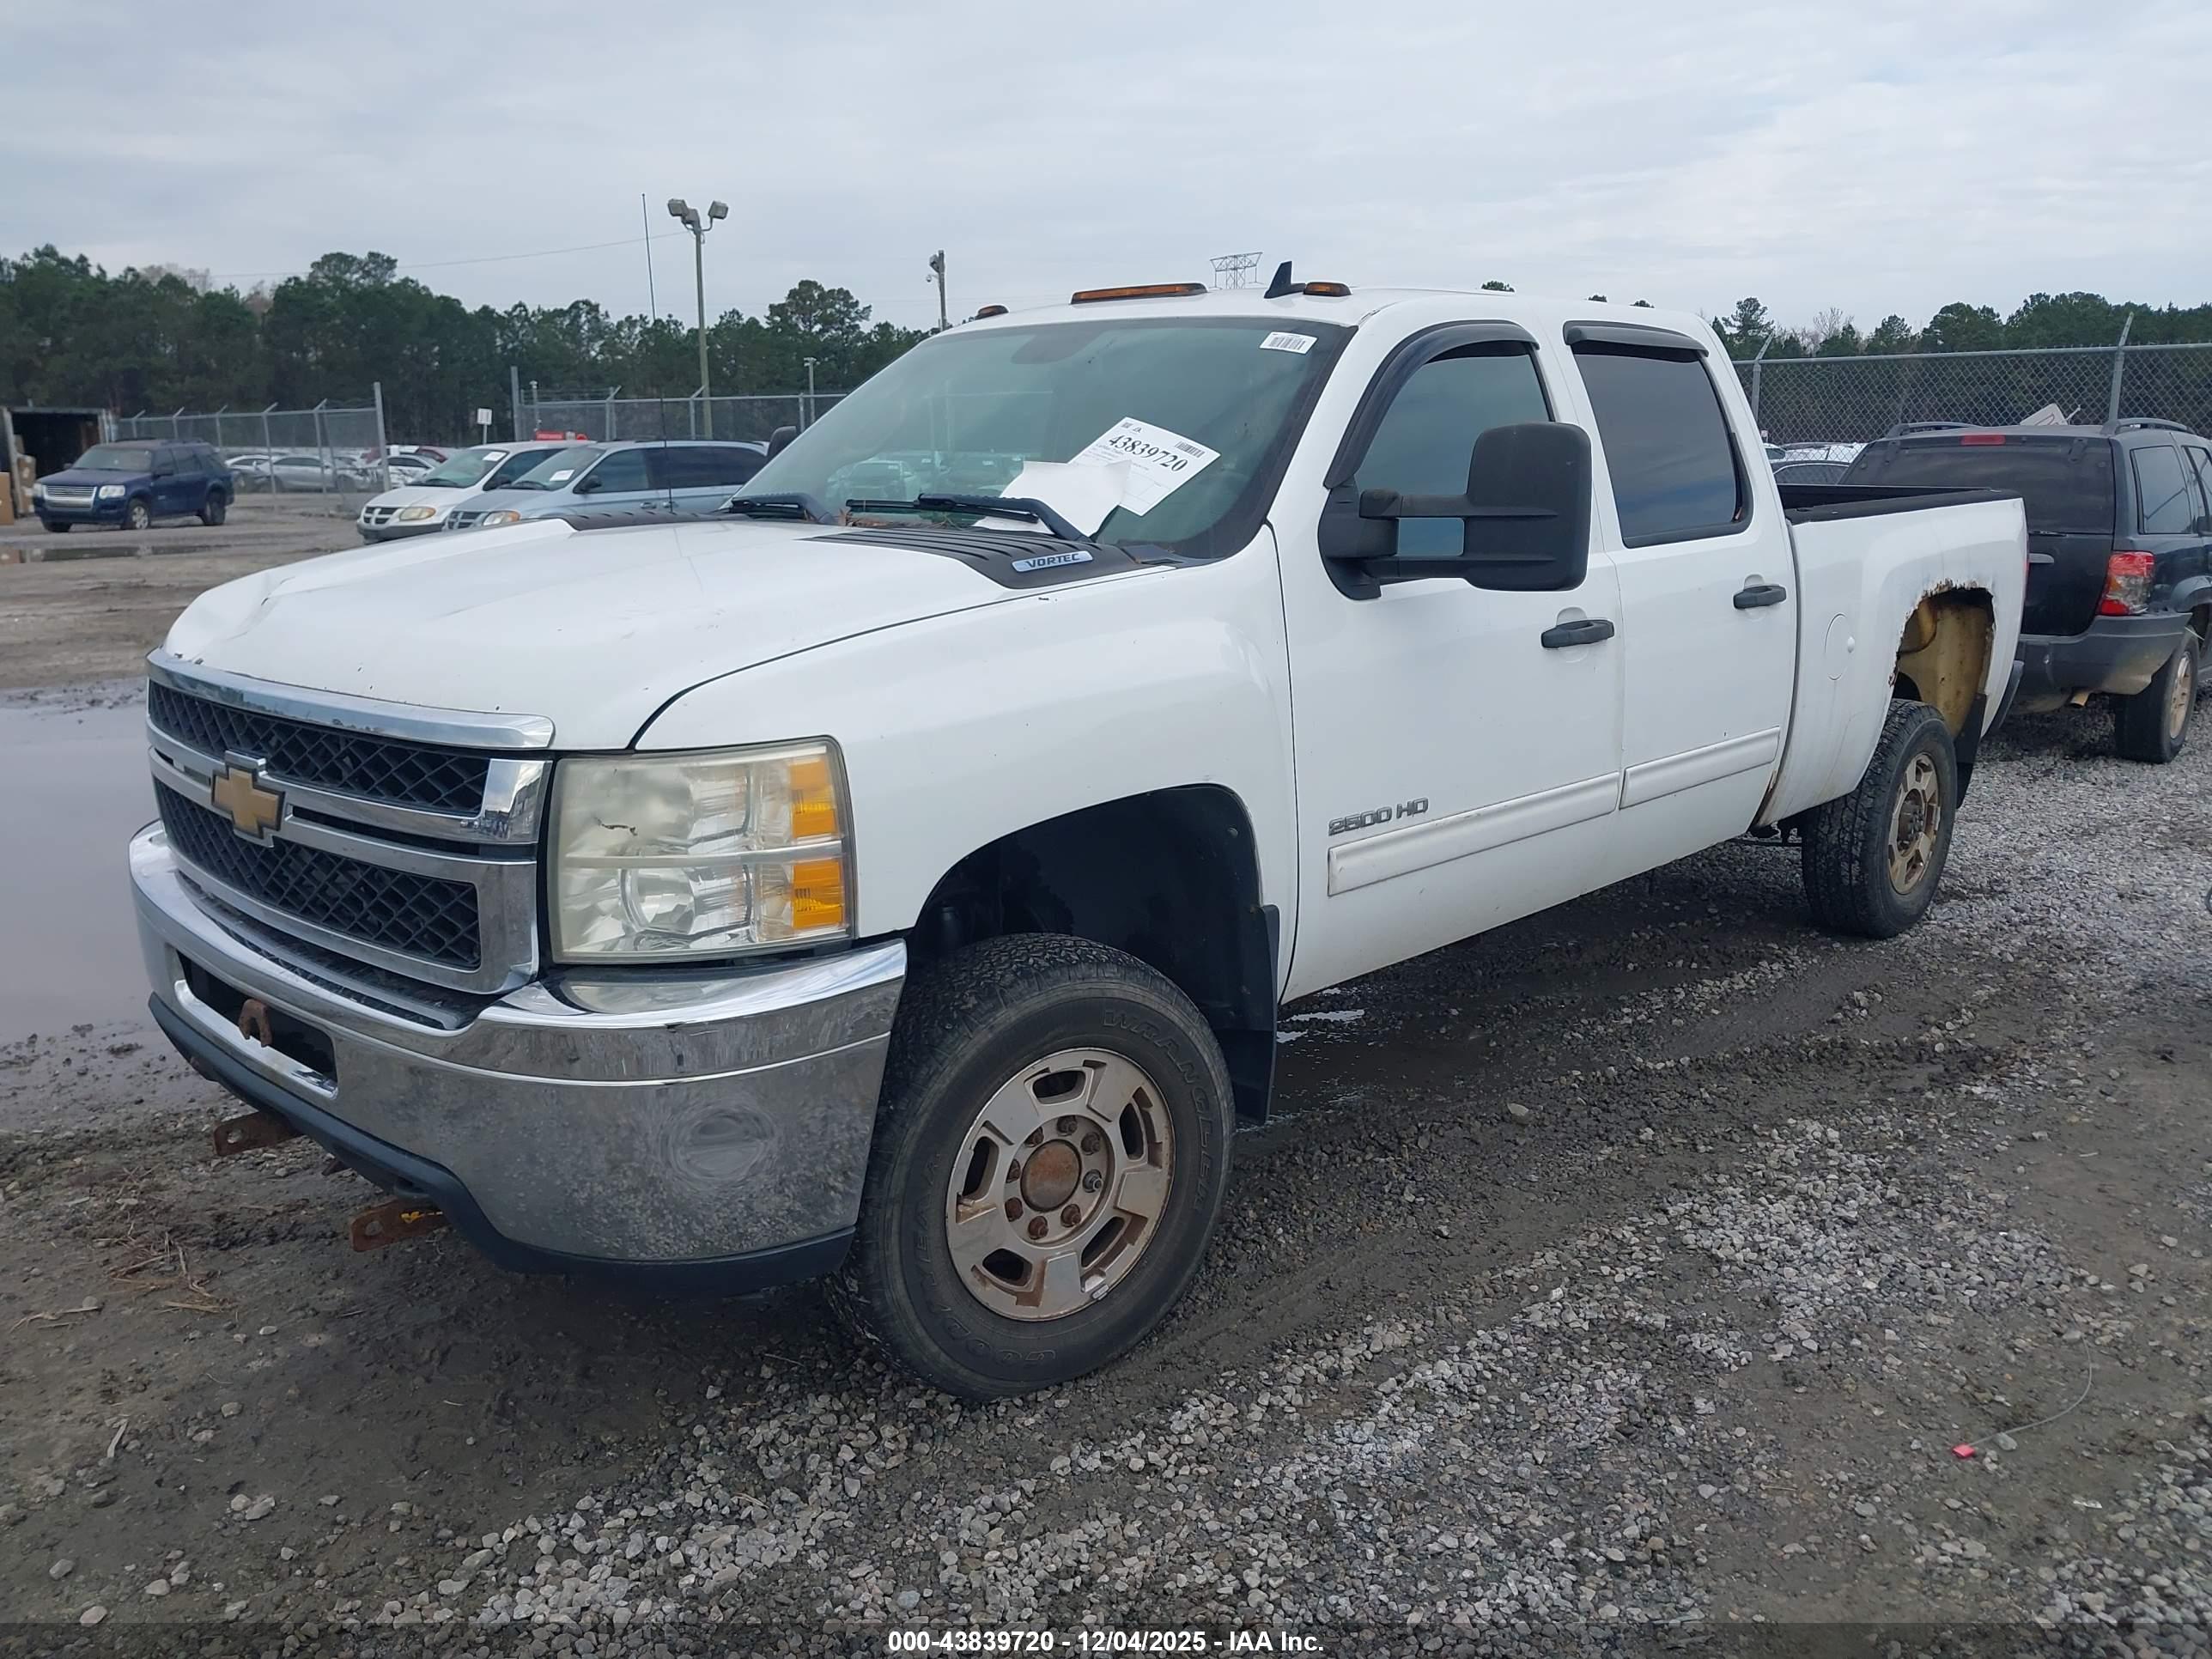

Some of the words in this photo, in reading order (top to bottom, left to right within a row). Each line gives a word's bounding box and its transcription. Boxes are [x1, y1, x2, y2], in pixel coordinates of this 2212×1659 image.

[1109, 434, 1188, 472] 43839720
[1024, 553, 1079, 568] VORTEC
[1328, 806, 1393, 836] 2500
[1396, 797, 1429, 819] HD
[1103, 1010, 1213, 1210] WRANGLER
